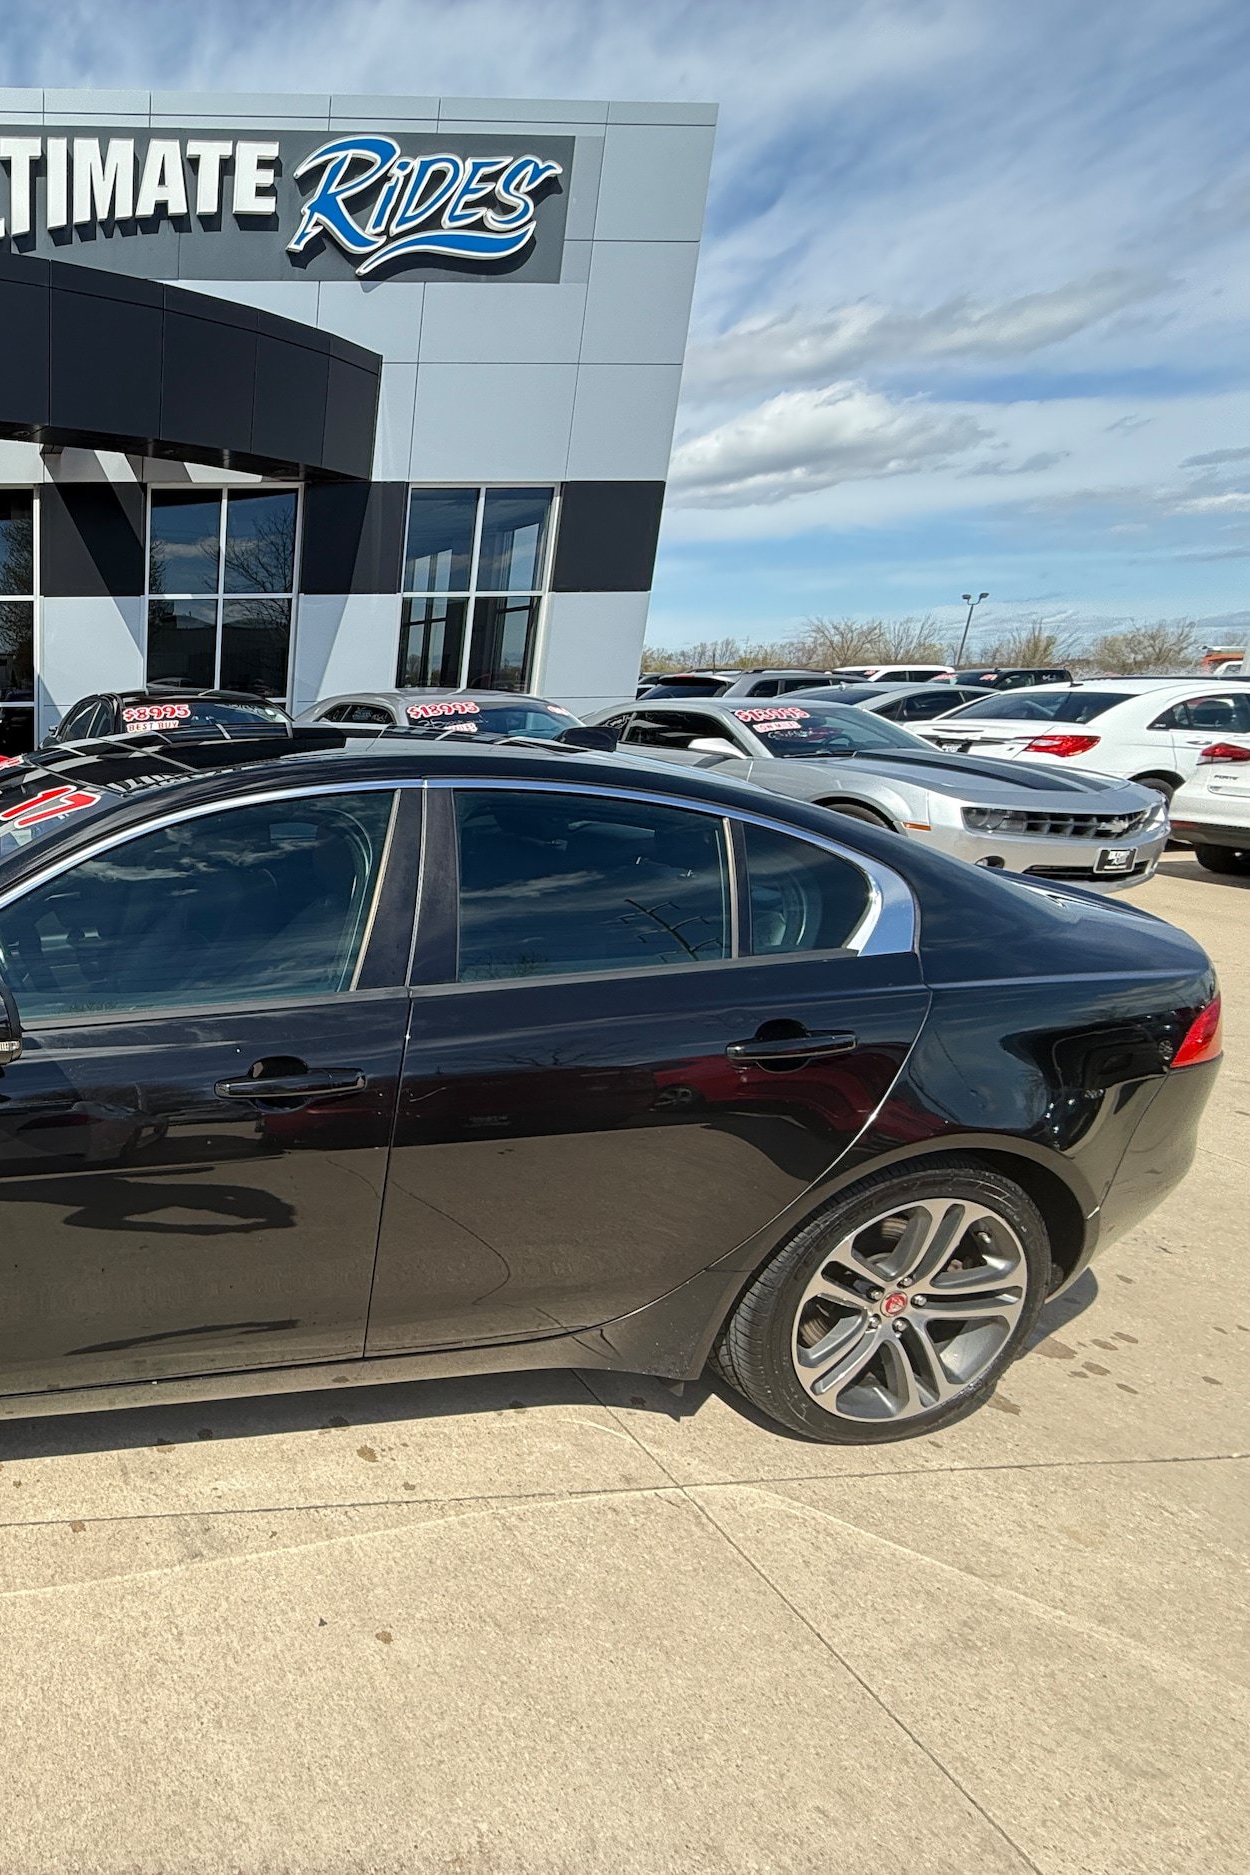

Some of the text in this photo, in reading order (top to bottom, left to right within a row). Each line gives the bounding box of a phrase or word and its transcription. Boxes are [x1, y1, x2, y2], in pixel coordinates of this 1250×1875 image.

[122, 704, 191, 722] $8995
[407, 702, 480, 718] $18995
[127, 720, 179, 732] BEST BUY
